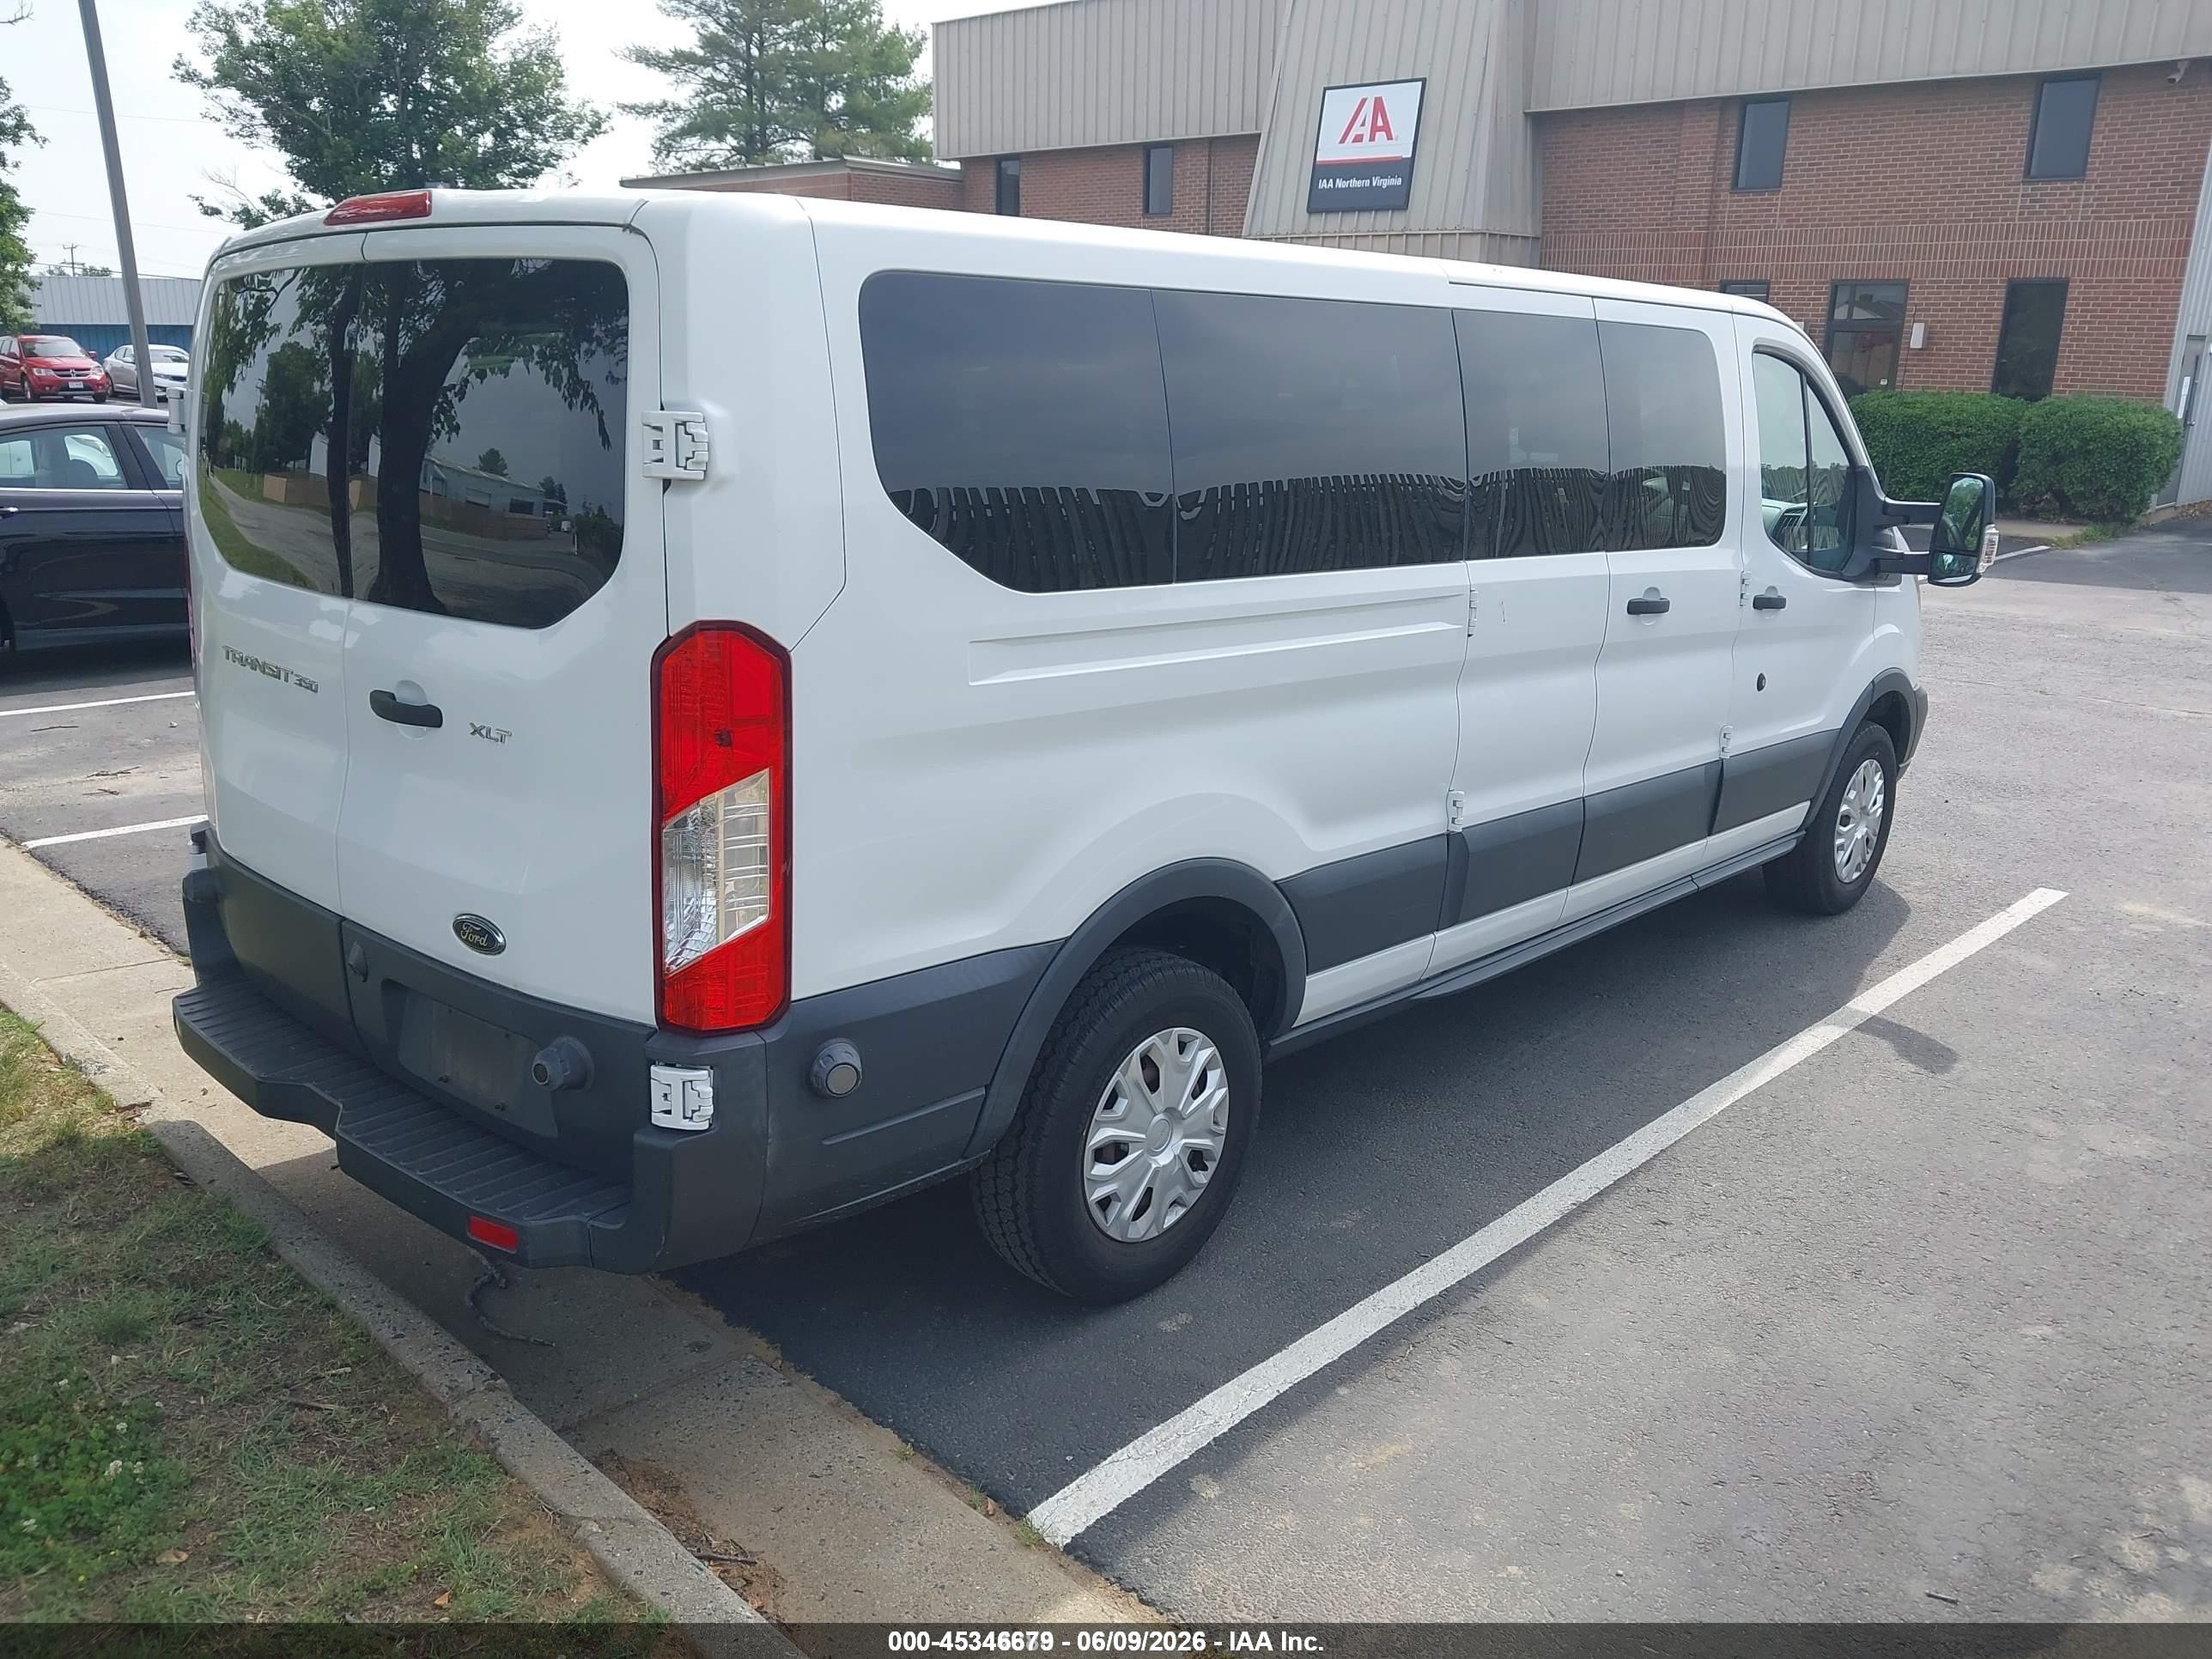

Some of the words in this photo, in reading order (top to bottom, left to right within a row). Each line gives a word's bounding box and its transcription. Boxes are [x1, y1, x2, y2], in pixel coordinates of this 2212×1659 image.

[1318, 178, 1334, 190] IAA
[1334, 173, 1370, 189] Northern
[1372, 171, 1402, 189] Virginia
[222, 644, 294, 684] TRANSIT
[469, 721, 513, 744] XLT
[460, 922, 489, 946] Ford
